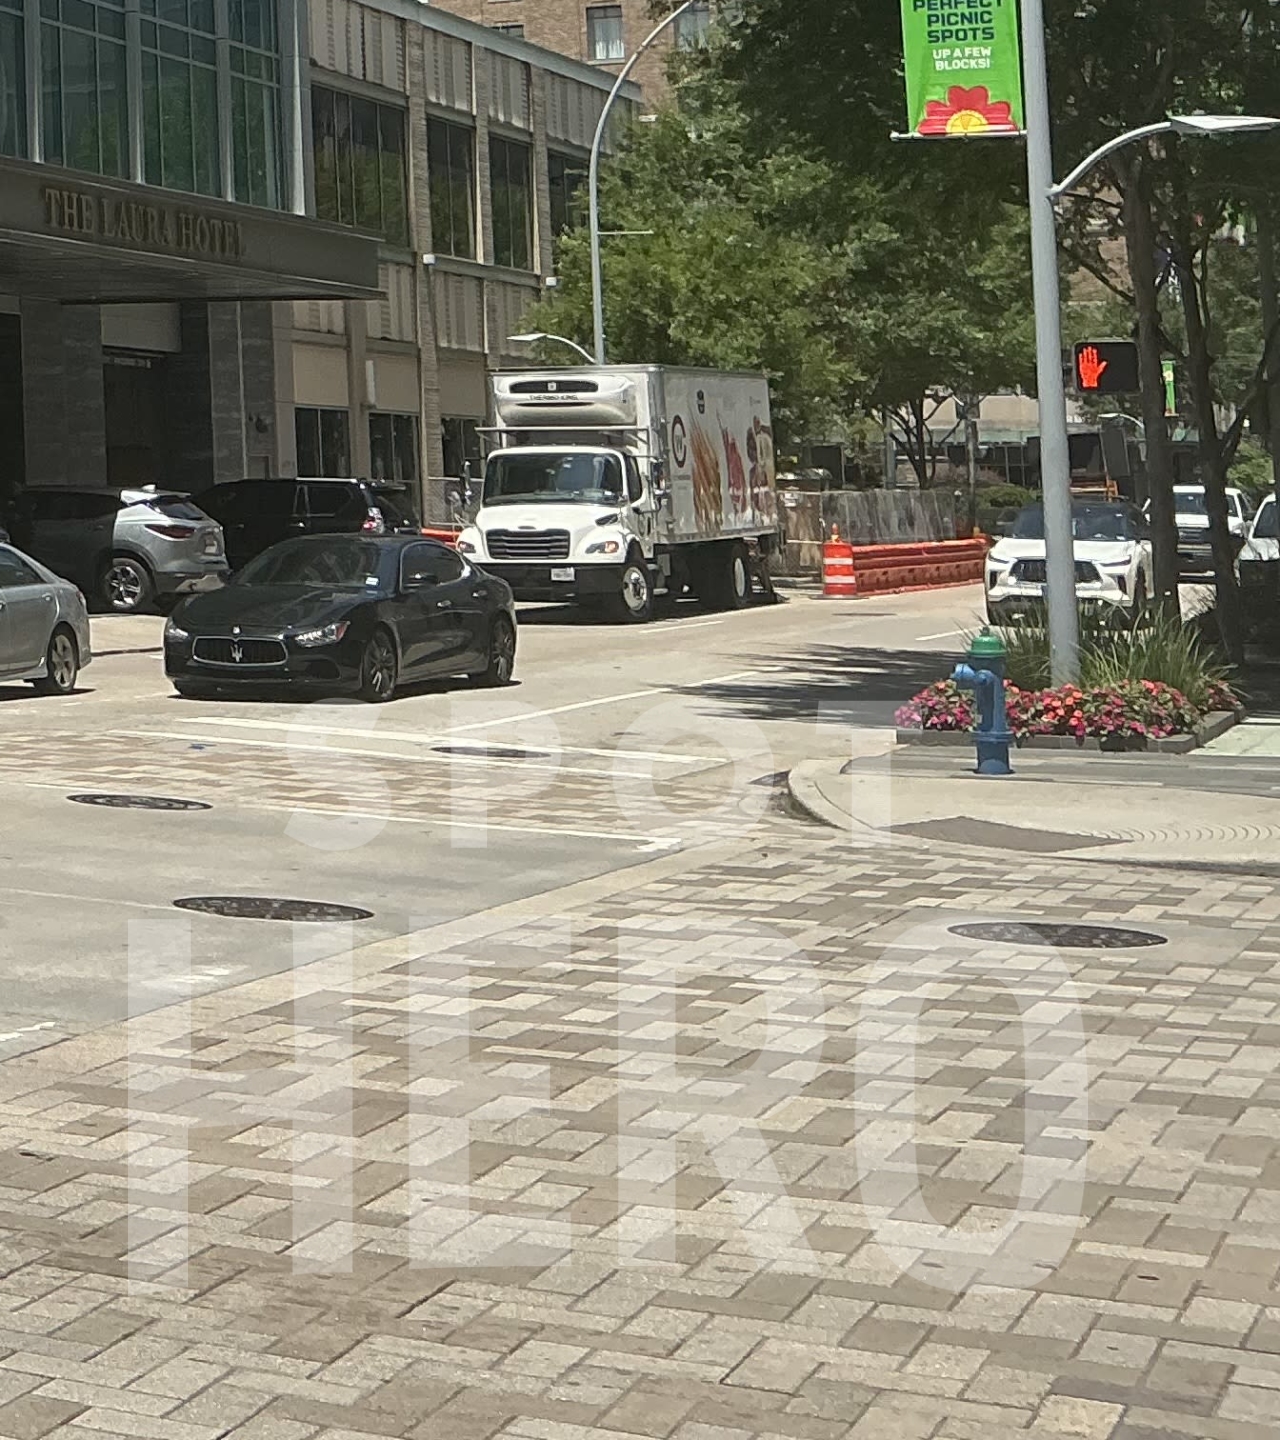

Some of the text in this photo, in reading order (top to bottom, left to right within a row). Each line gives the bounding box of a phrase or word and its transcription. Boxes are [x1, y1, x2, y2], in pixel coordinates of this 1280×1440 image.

[927, 10, 993, 27] PICNIC
[927, 27, 995, 44] SPOTS
[933, 46, 992, 61] UP A FEW
[45, 188, 245, 257] THE LAURA HOTEL
